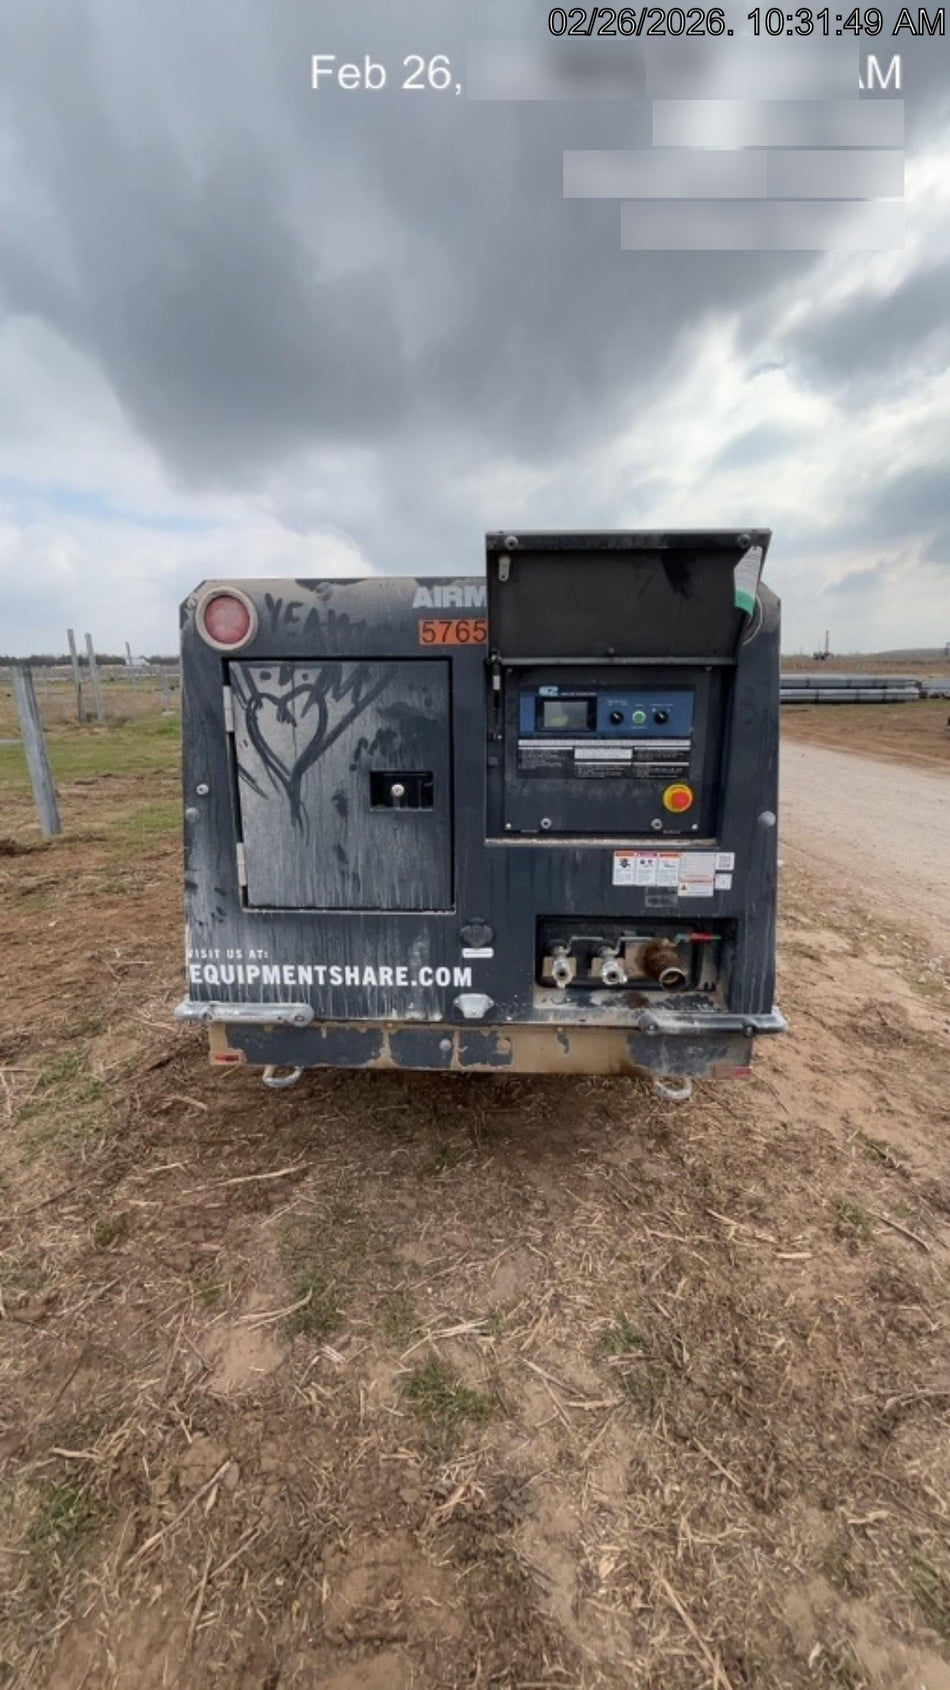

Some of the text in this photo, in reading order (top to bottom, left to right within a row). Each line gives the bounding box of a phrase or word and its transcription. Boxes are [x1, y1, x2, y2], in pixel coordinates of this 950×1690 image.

[422, 620, 488, 643] 5765
[227, 949, 243, 959] US
[249, 949, 268, 960] AT:
[189, 963, 472, 987] EQUIPMENTSHARE.COM
